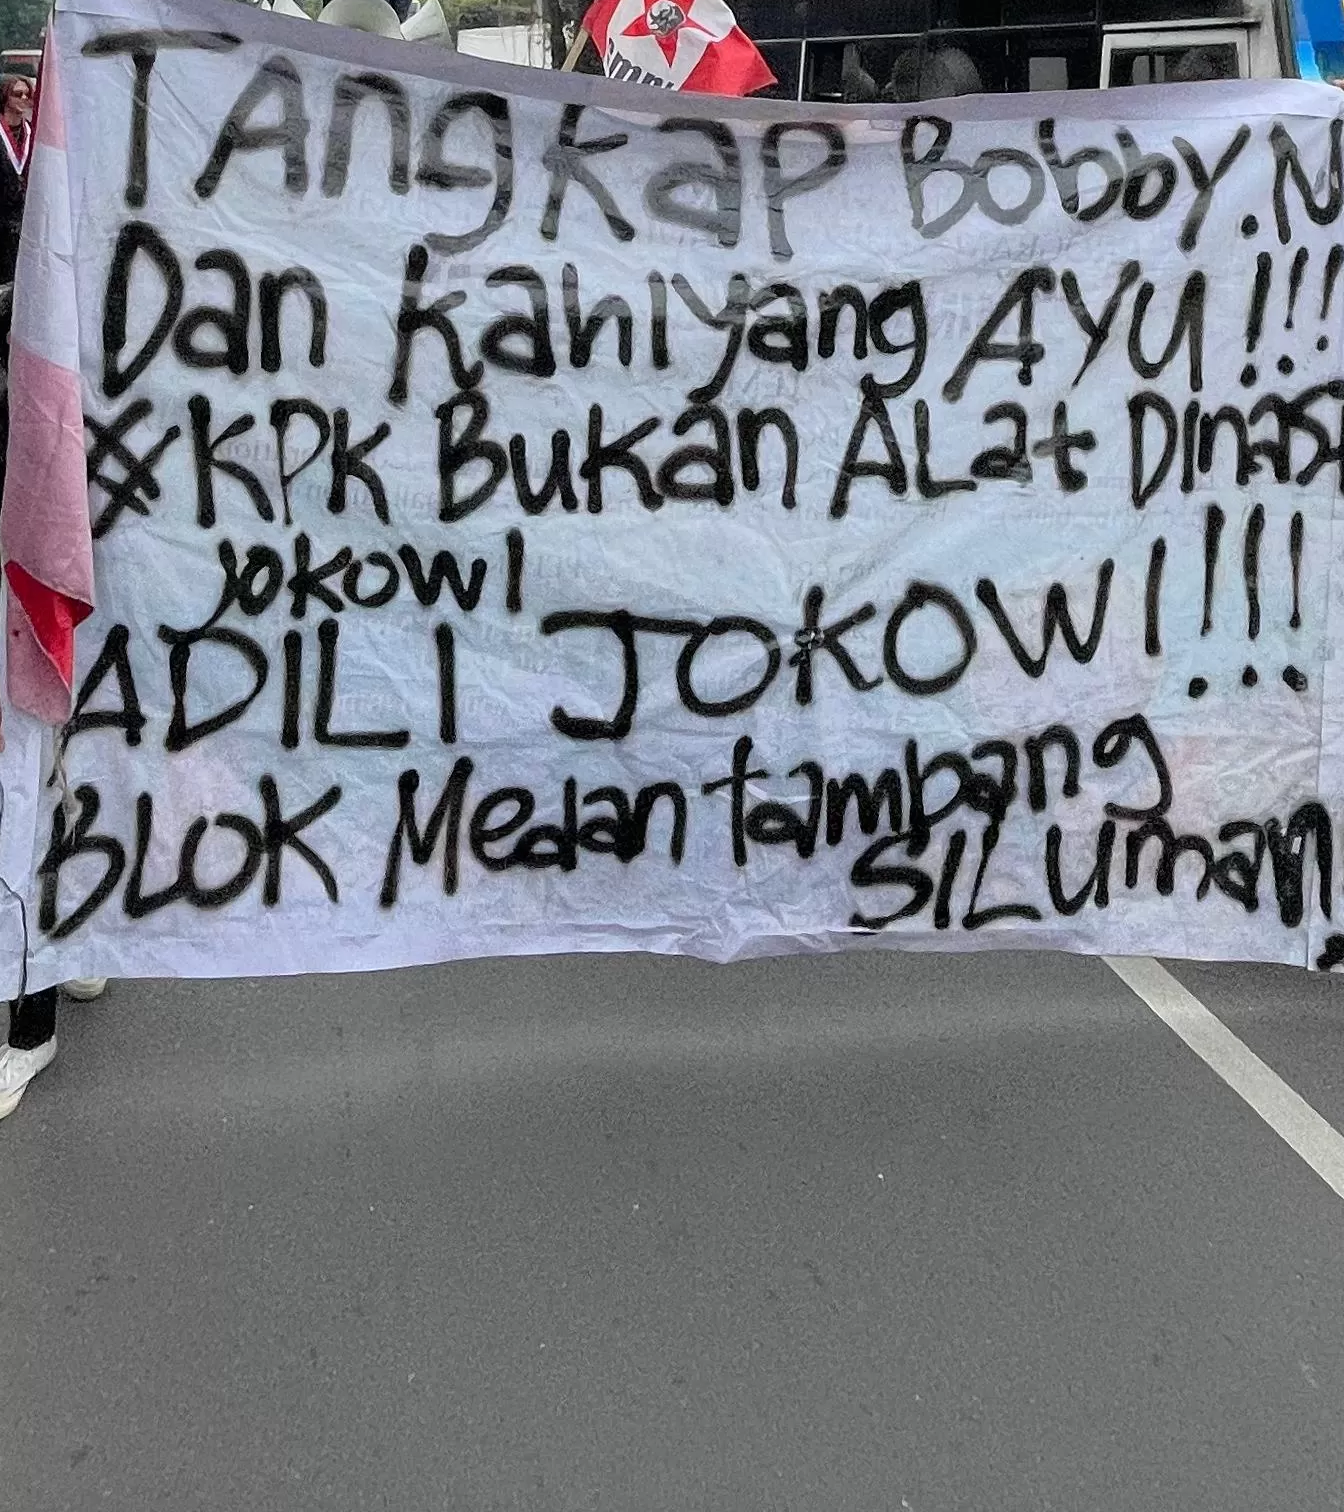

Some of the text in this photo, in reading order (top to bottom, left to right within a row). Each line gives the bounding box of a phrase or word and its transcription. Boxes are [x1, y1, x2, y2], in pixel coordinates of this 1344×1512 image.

[101, 221, 326, 397] Dan
[380, 755, 688, 908] Medan
[700, 713, 1173, 868] tambang
